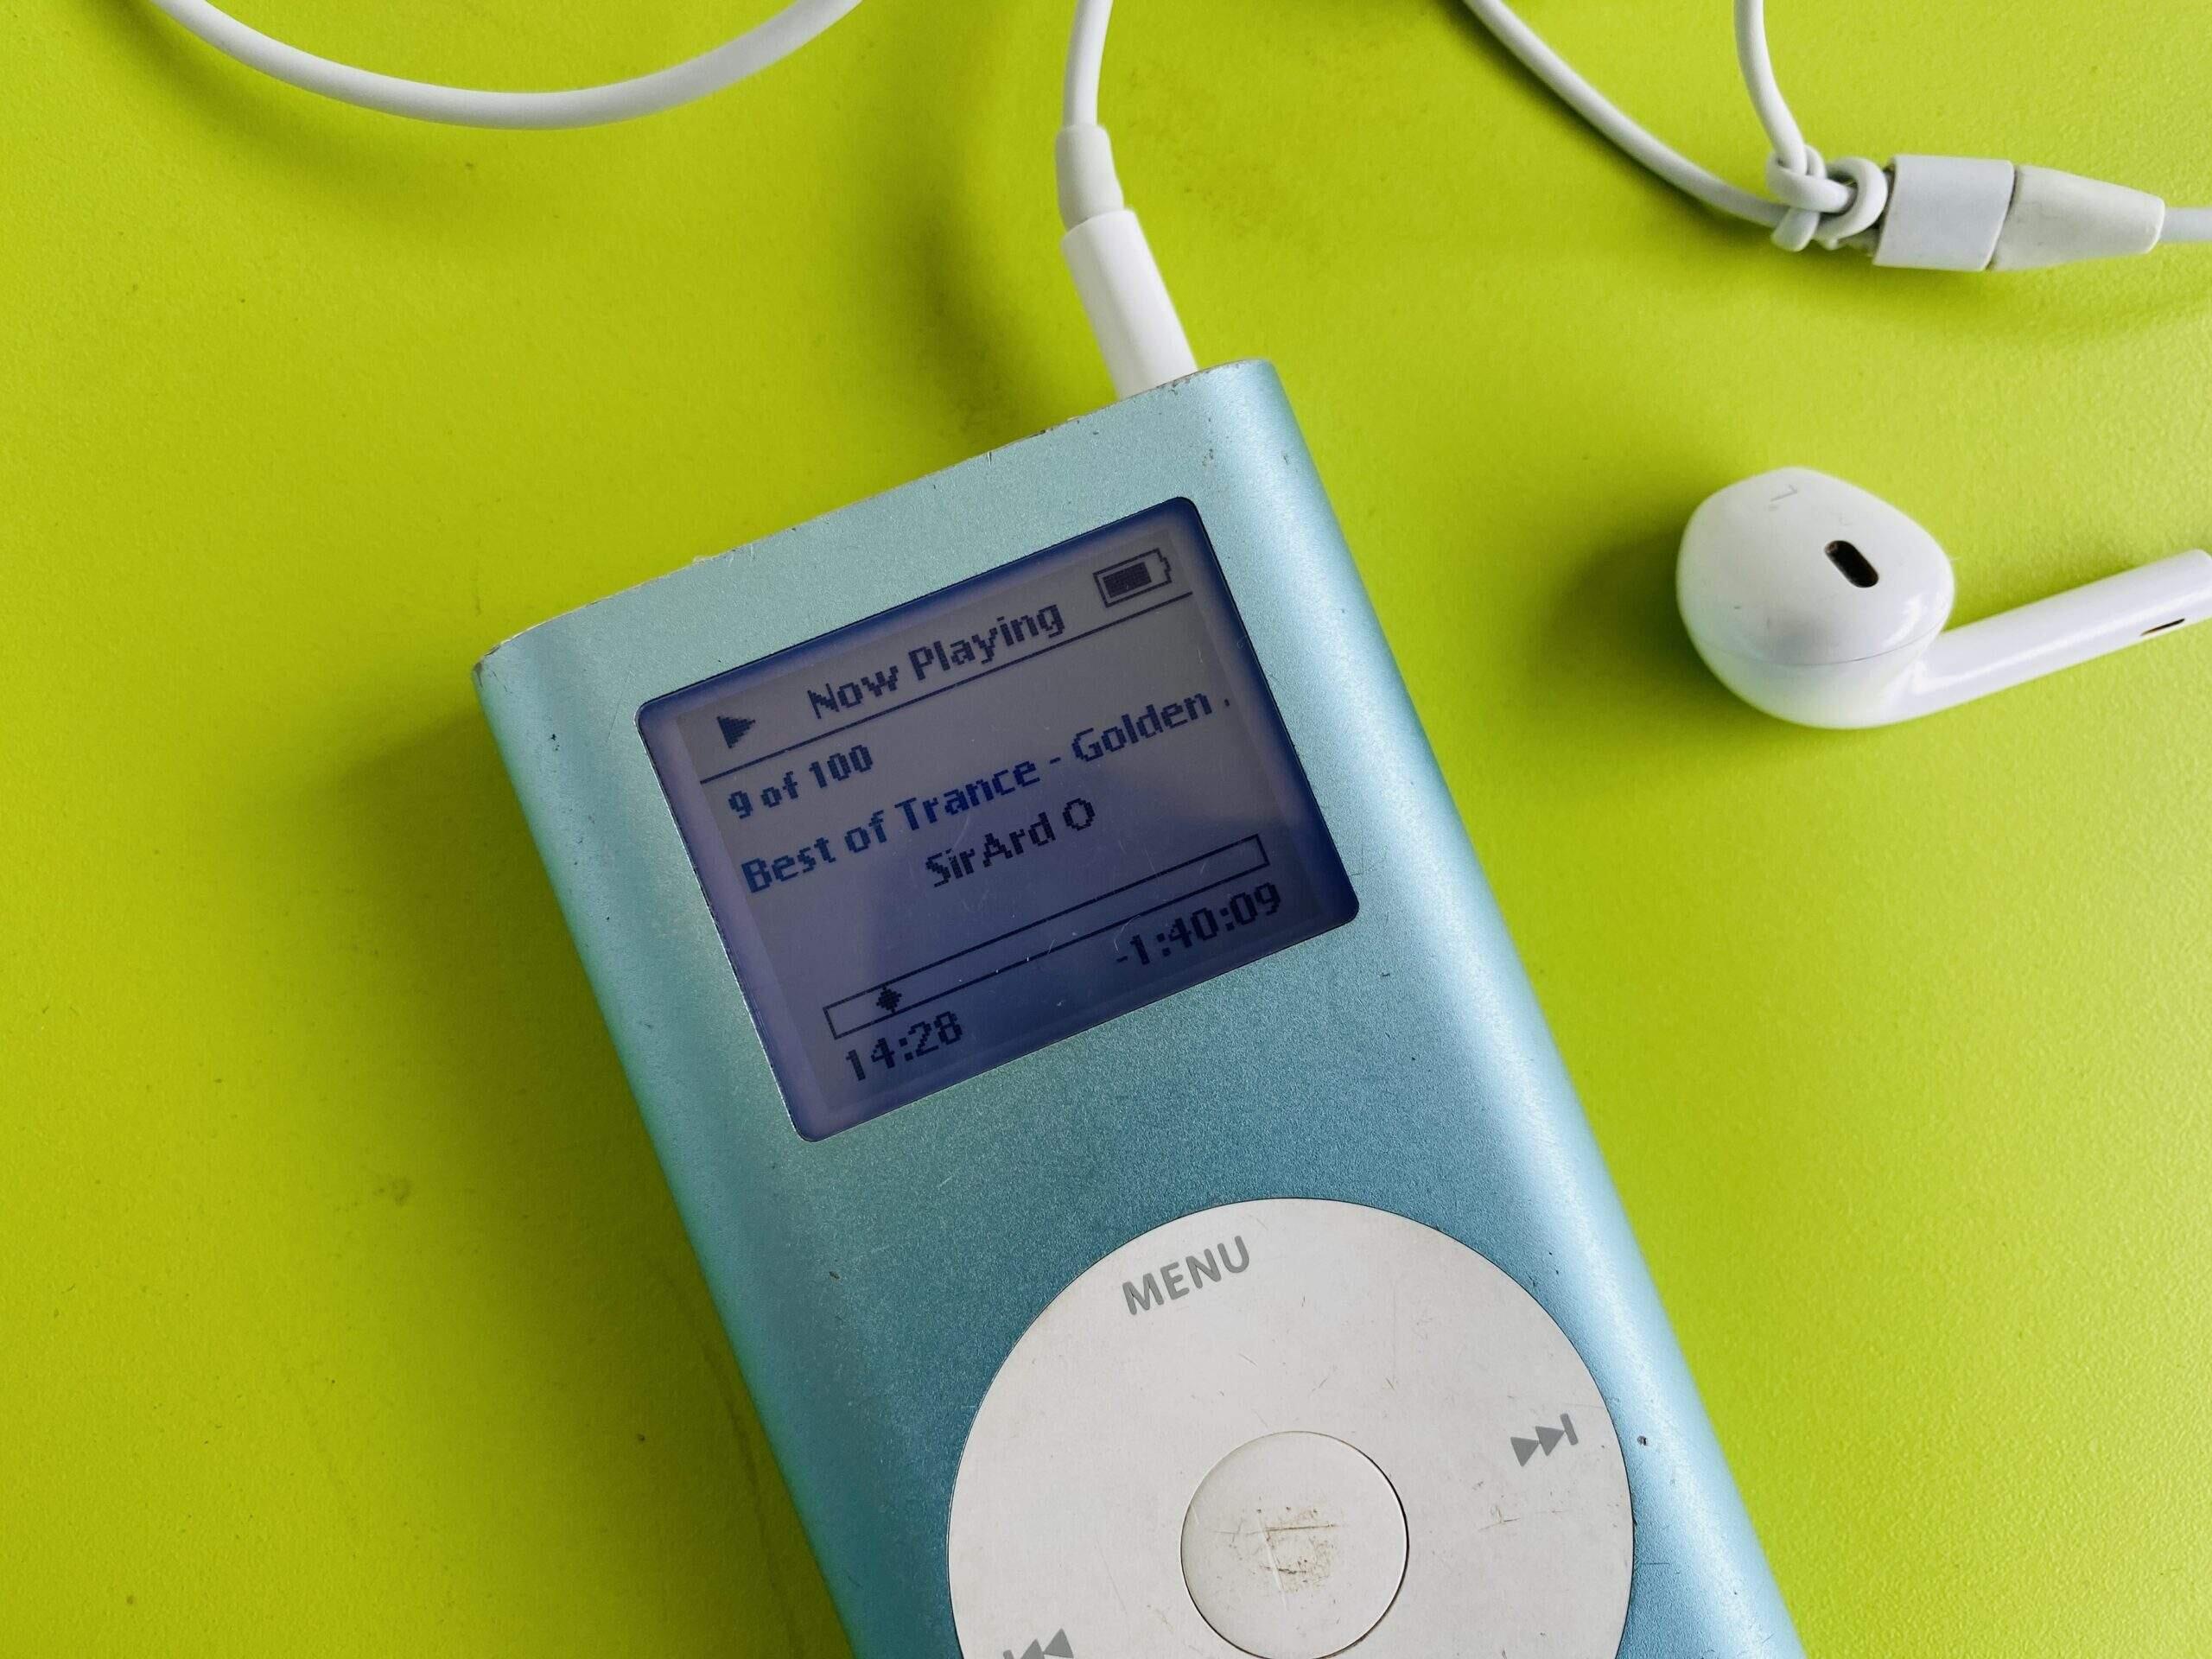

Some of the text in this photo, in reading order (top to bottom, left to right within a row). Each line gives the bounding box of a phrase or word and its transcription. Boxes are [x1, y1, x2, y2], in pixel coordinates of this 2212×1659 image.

[807, 603, 1066, 720] Now Playing
[728, 744, 874, 820] 9 of 100
[741, 837, 836, 893] Best
[845, 813, 886, 852] of
[894, 760, 1041, 832] Trance
[1071, 694, 1212, 763] Golden
[925, 812, 1056, 887] SirArd
[1116, 882, 1282, 967] -1:40:09
[845, 1010, 964, 1081] 14:28
[1122, 1235, 1251, 1315] MENU
